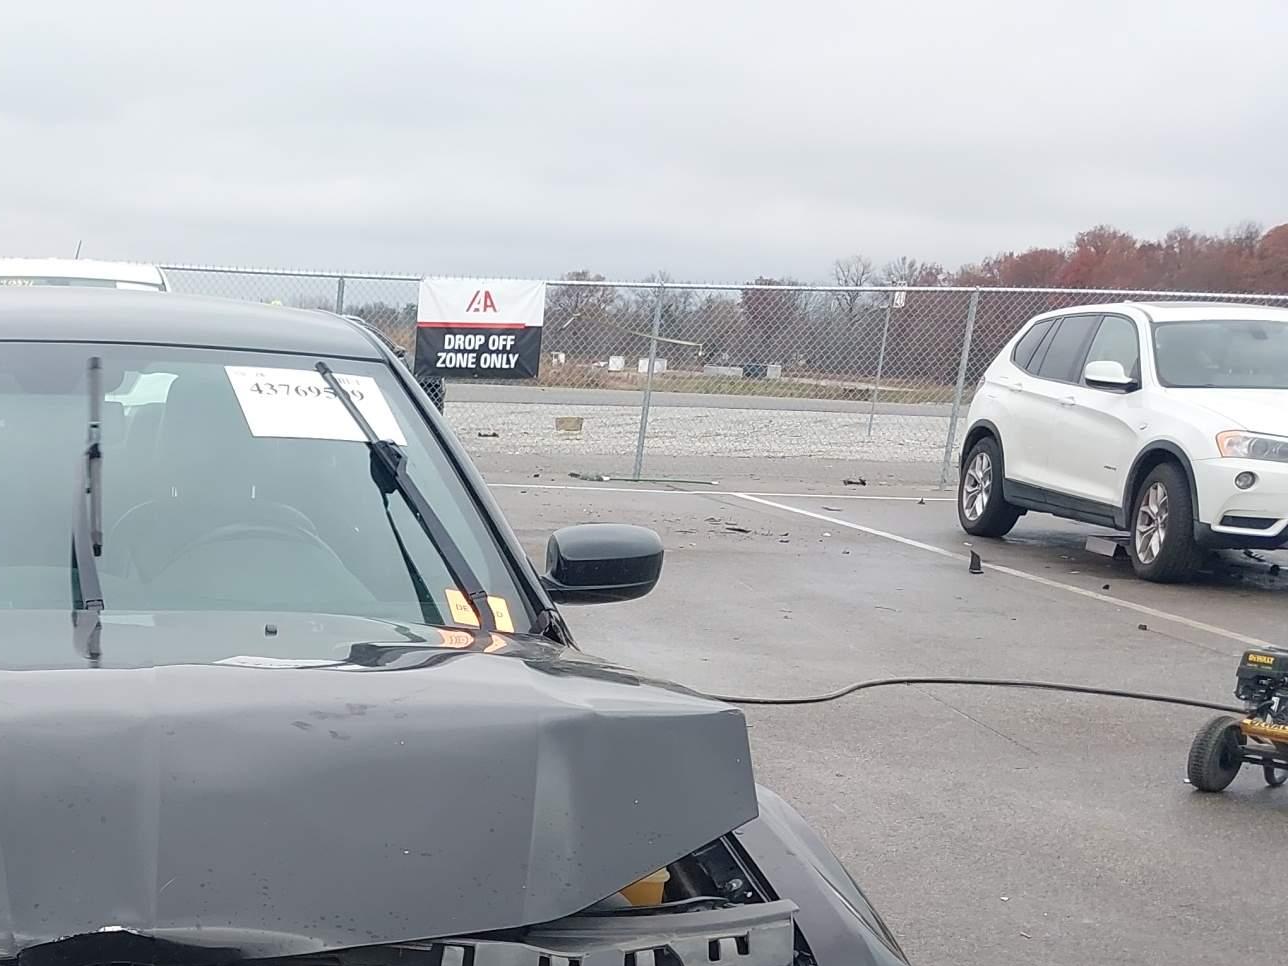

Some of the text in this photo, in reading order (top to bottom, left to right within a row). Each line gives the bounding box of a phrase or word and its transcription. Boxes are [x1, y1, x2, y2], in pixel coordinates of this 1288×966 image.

[443, 334, 516, 351] DROP OFF
[435, 352, 520, 369] ZONE ONLY
[249, 381, 365, 401] 4376959
